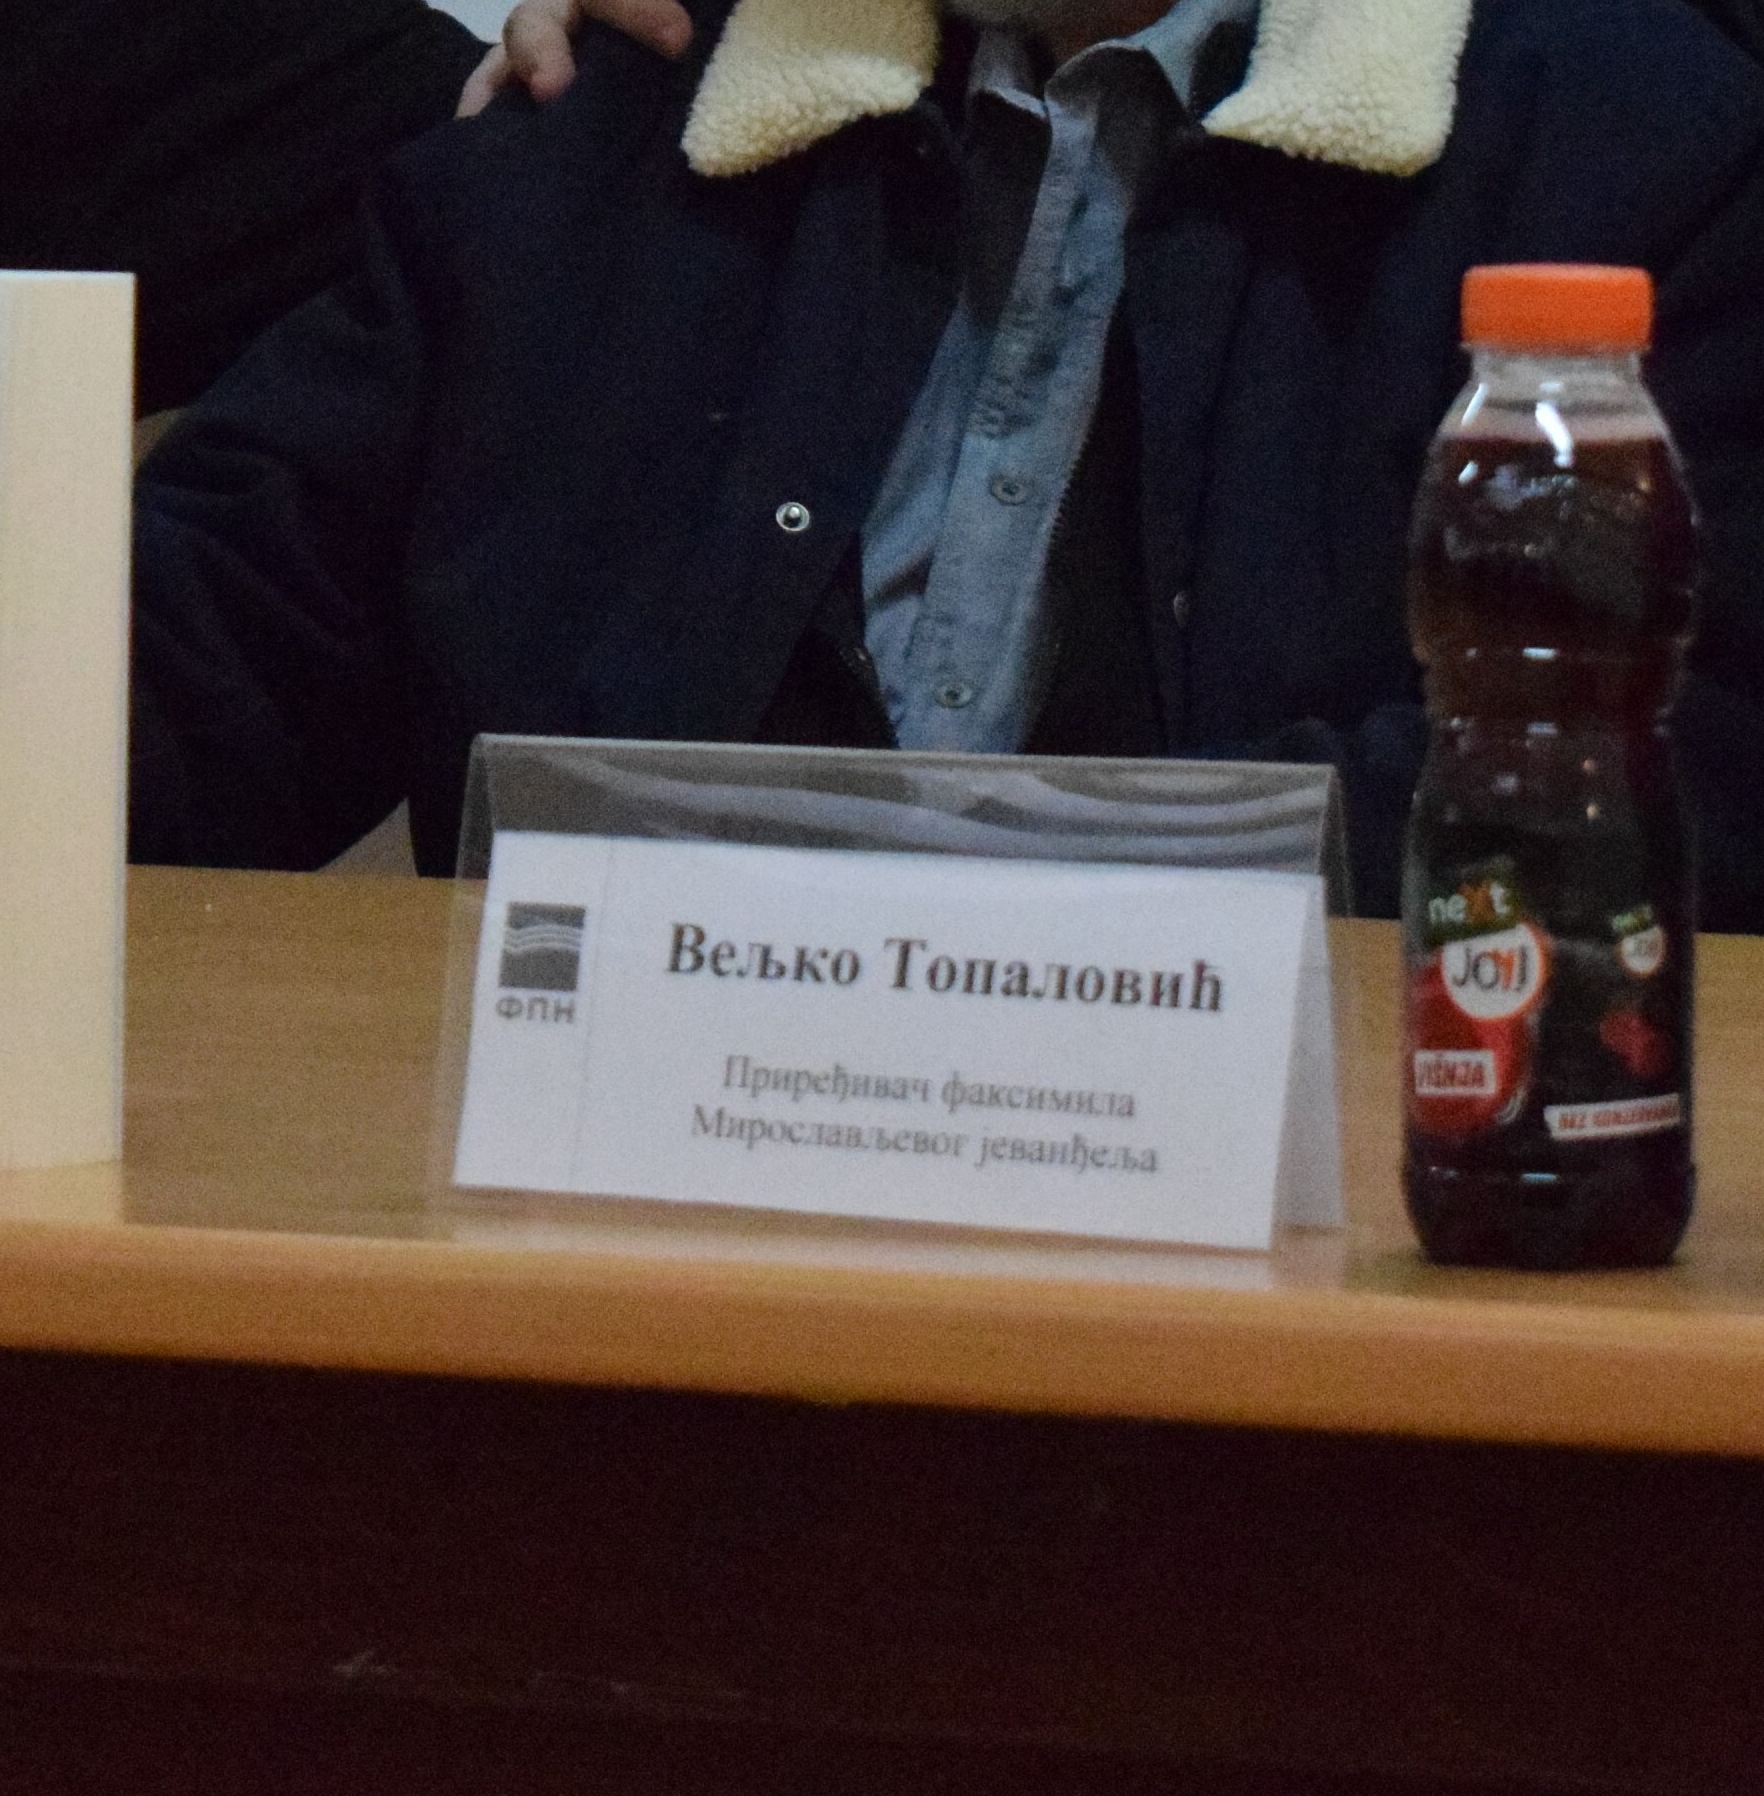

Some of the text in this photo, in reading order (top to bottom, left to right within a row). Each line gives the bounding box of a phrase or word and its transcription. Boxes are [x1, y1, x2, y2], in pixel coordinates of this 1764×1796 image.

[667, 922, 1223, 1013] Вељко Топаловић
[495, 996, 577, 1023] ФПН
[722, 1053, 1136, 1119] Приређивач факсимила
[692, 1104, 1159, 1174] Мирослављевог јеванђеља
